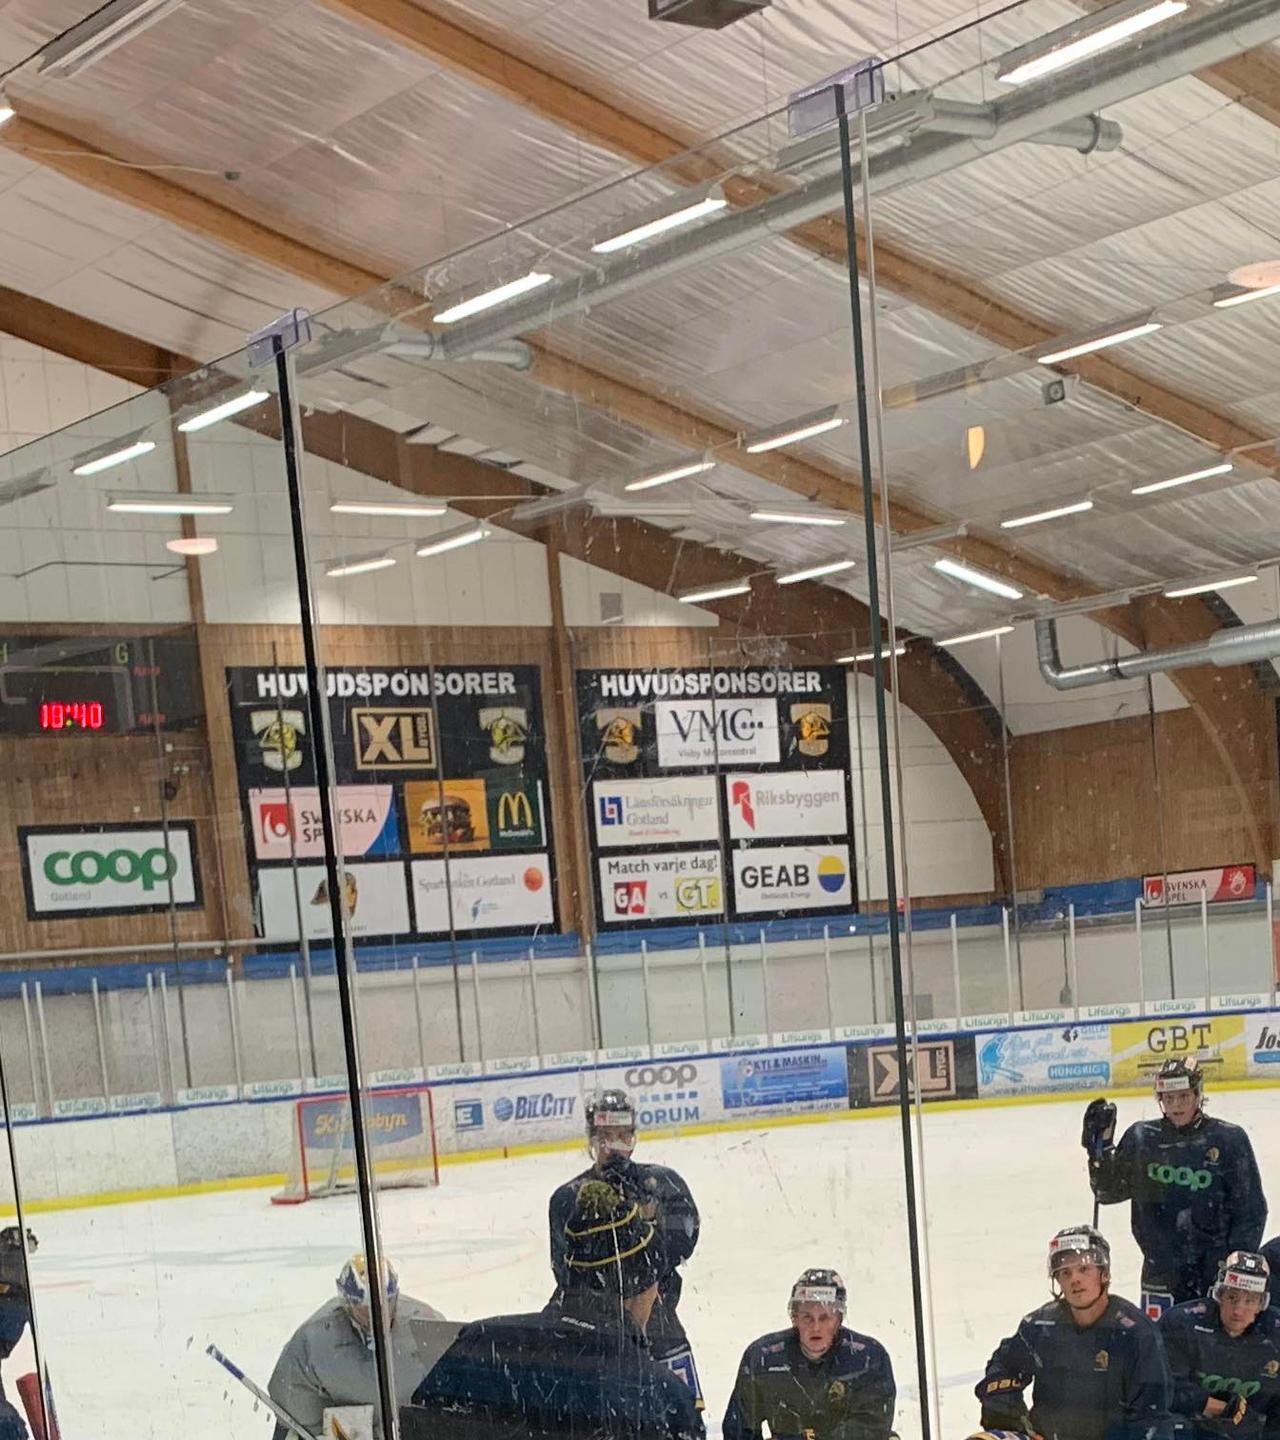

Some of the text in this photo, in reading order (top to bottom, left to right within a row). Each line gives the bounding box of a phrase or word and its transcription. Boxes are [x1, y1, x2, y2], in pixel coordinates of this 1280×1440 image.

[115, 642, 129, 664] G
[600, 671, 822, 697] HUVUDSPONSORER
[670, 708, 756, 743] VMC
[359, 716, 431, 762] XL
[755, 790, 840, 808] Riksbyggen
[301, 807, 377, 825] SVSKA
[627, 811, 669, 826] Gotland
[43, 847, 178, 891] coop
[607, 855, 718, 875] Match varje dag!
[740, 863, 810, 889] GEAB
[1147, 1024, 1212, 1053] GBT
[624, 1064, 698, 1088] coop
[634, 1107, 700, 1126] ORUM
[1148, 1162, 1213, 1192] coop
